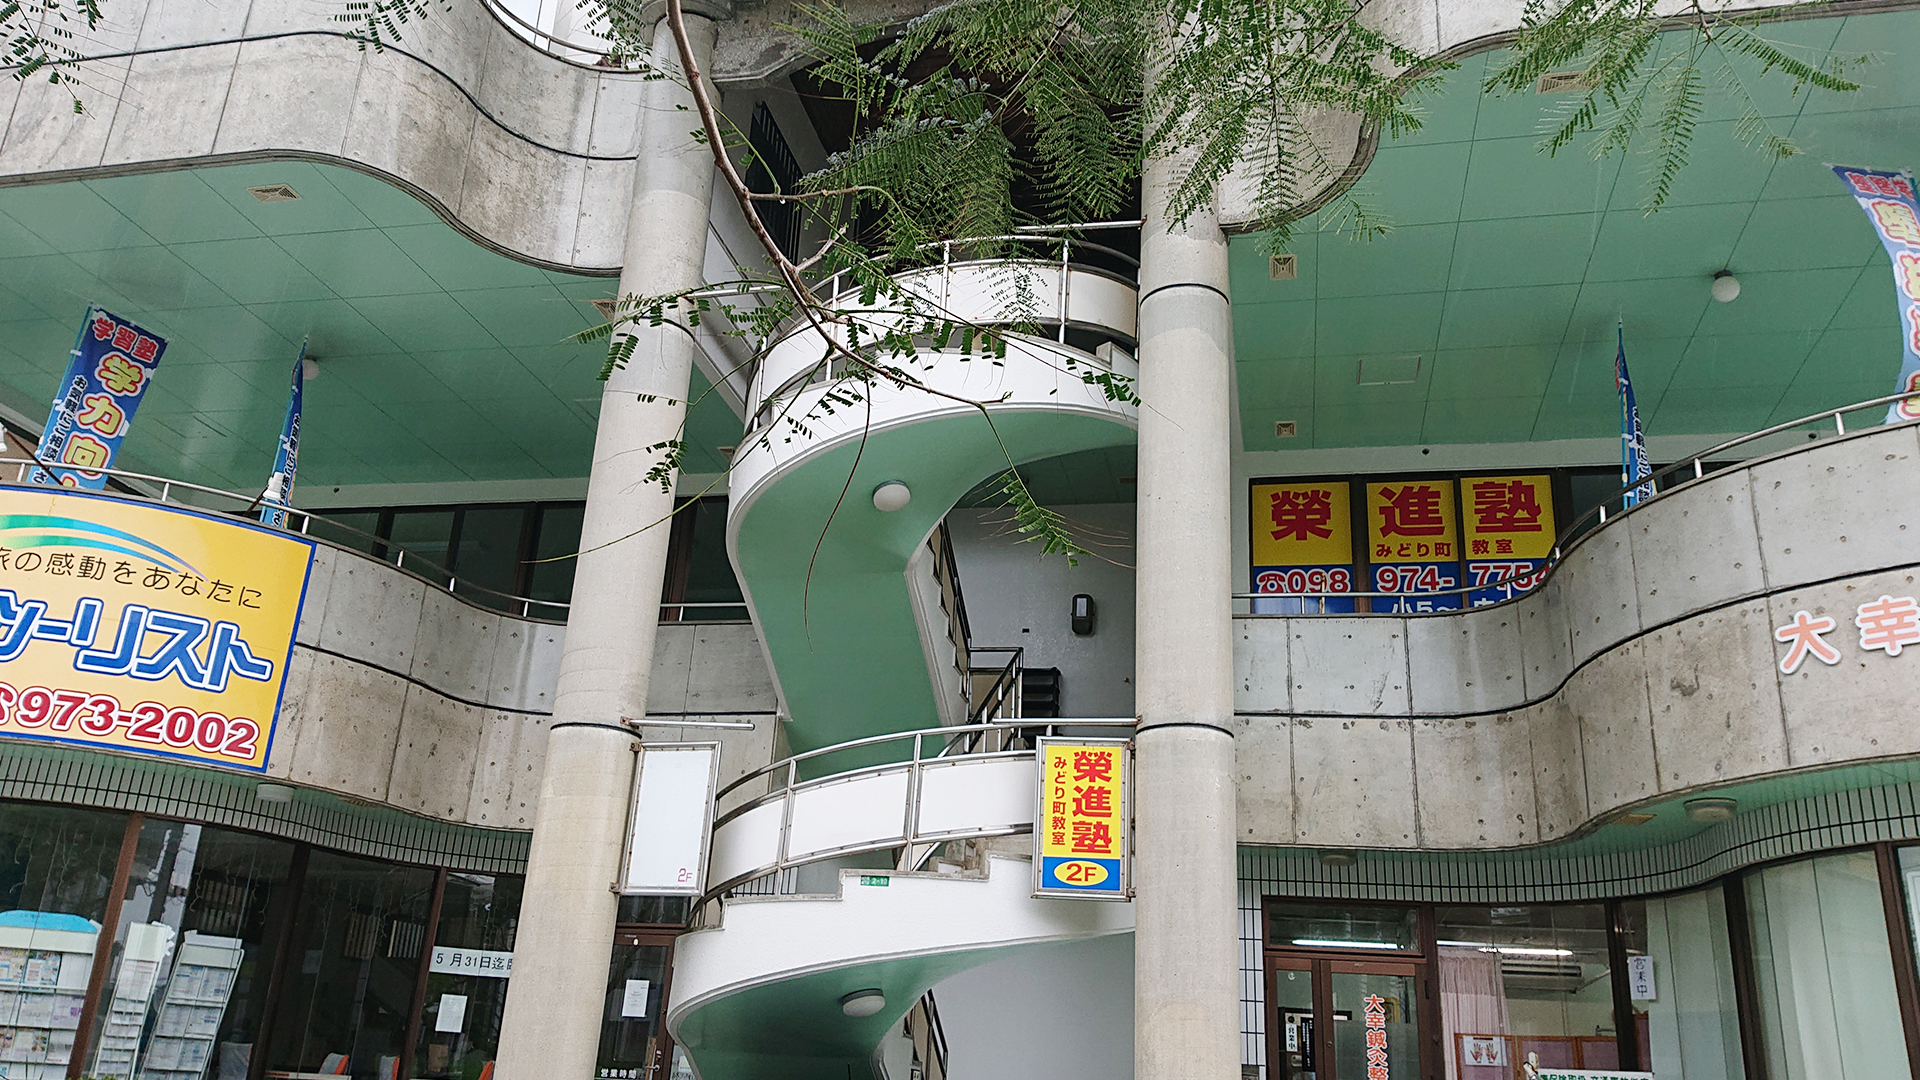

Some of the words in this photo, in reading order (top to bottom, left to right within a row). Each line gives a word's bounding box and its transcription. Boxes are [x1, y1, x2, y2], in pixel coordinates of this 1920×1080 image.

[93, 317, 158, 362] 学習塾
[60, 352, 147, 487] 学力向
[1286, 568, 1350, 593] 098
[1377, 566, 1455, 592] 974-
[15, 685, 260, 759] 973-2002
[1051, 756, 1067, 845] みどり町教室
[678, 868, 693, 882] 2F
[1066, 863, 1097, 882] 2F
